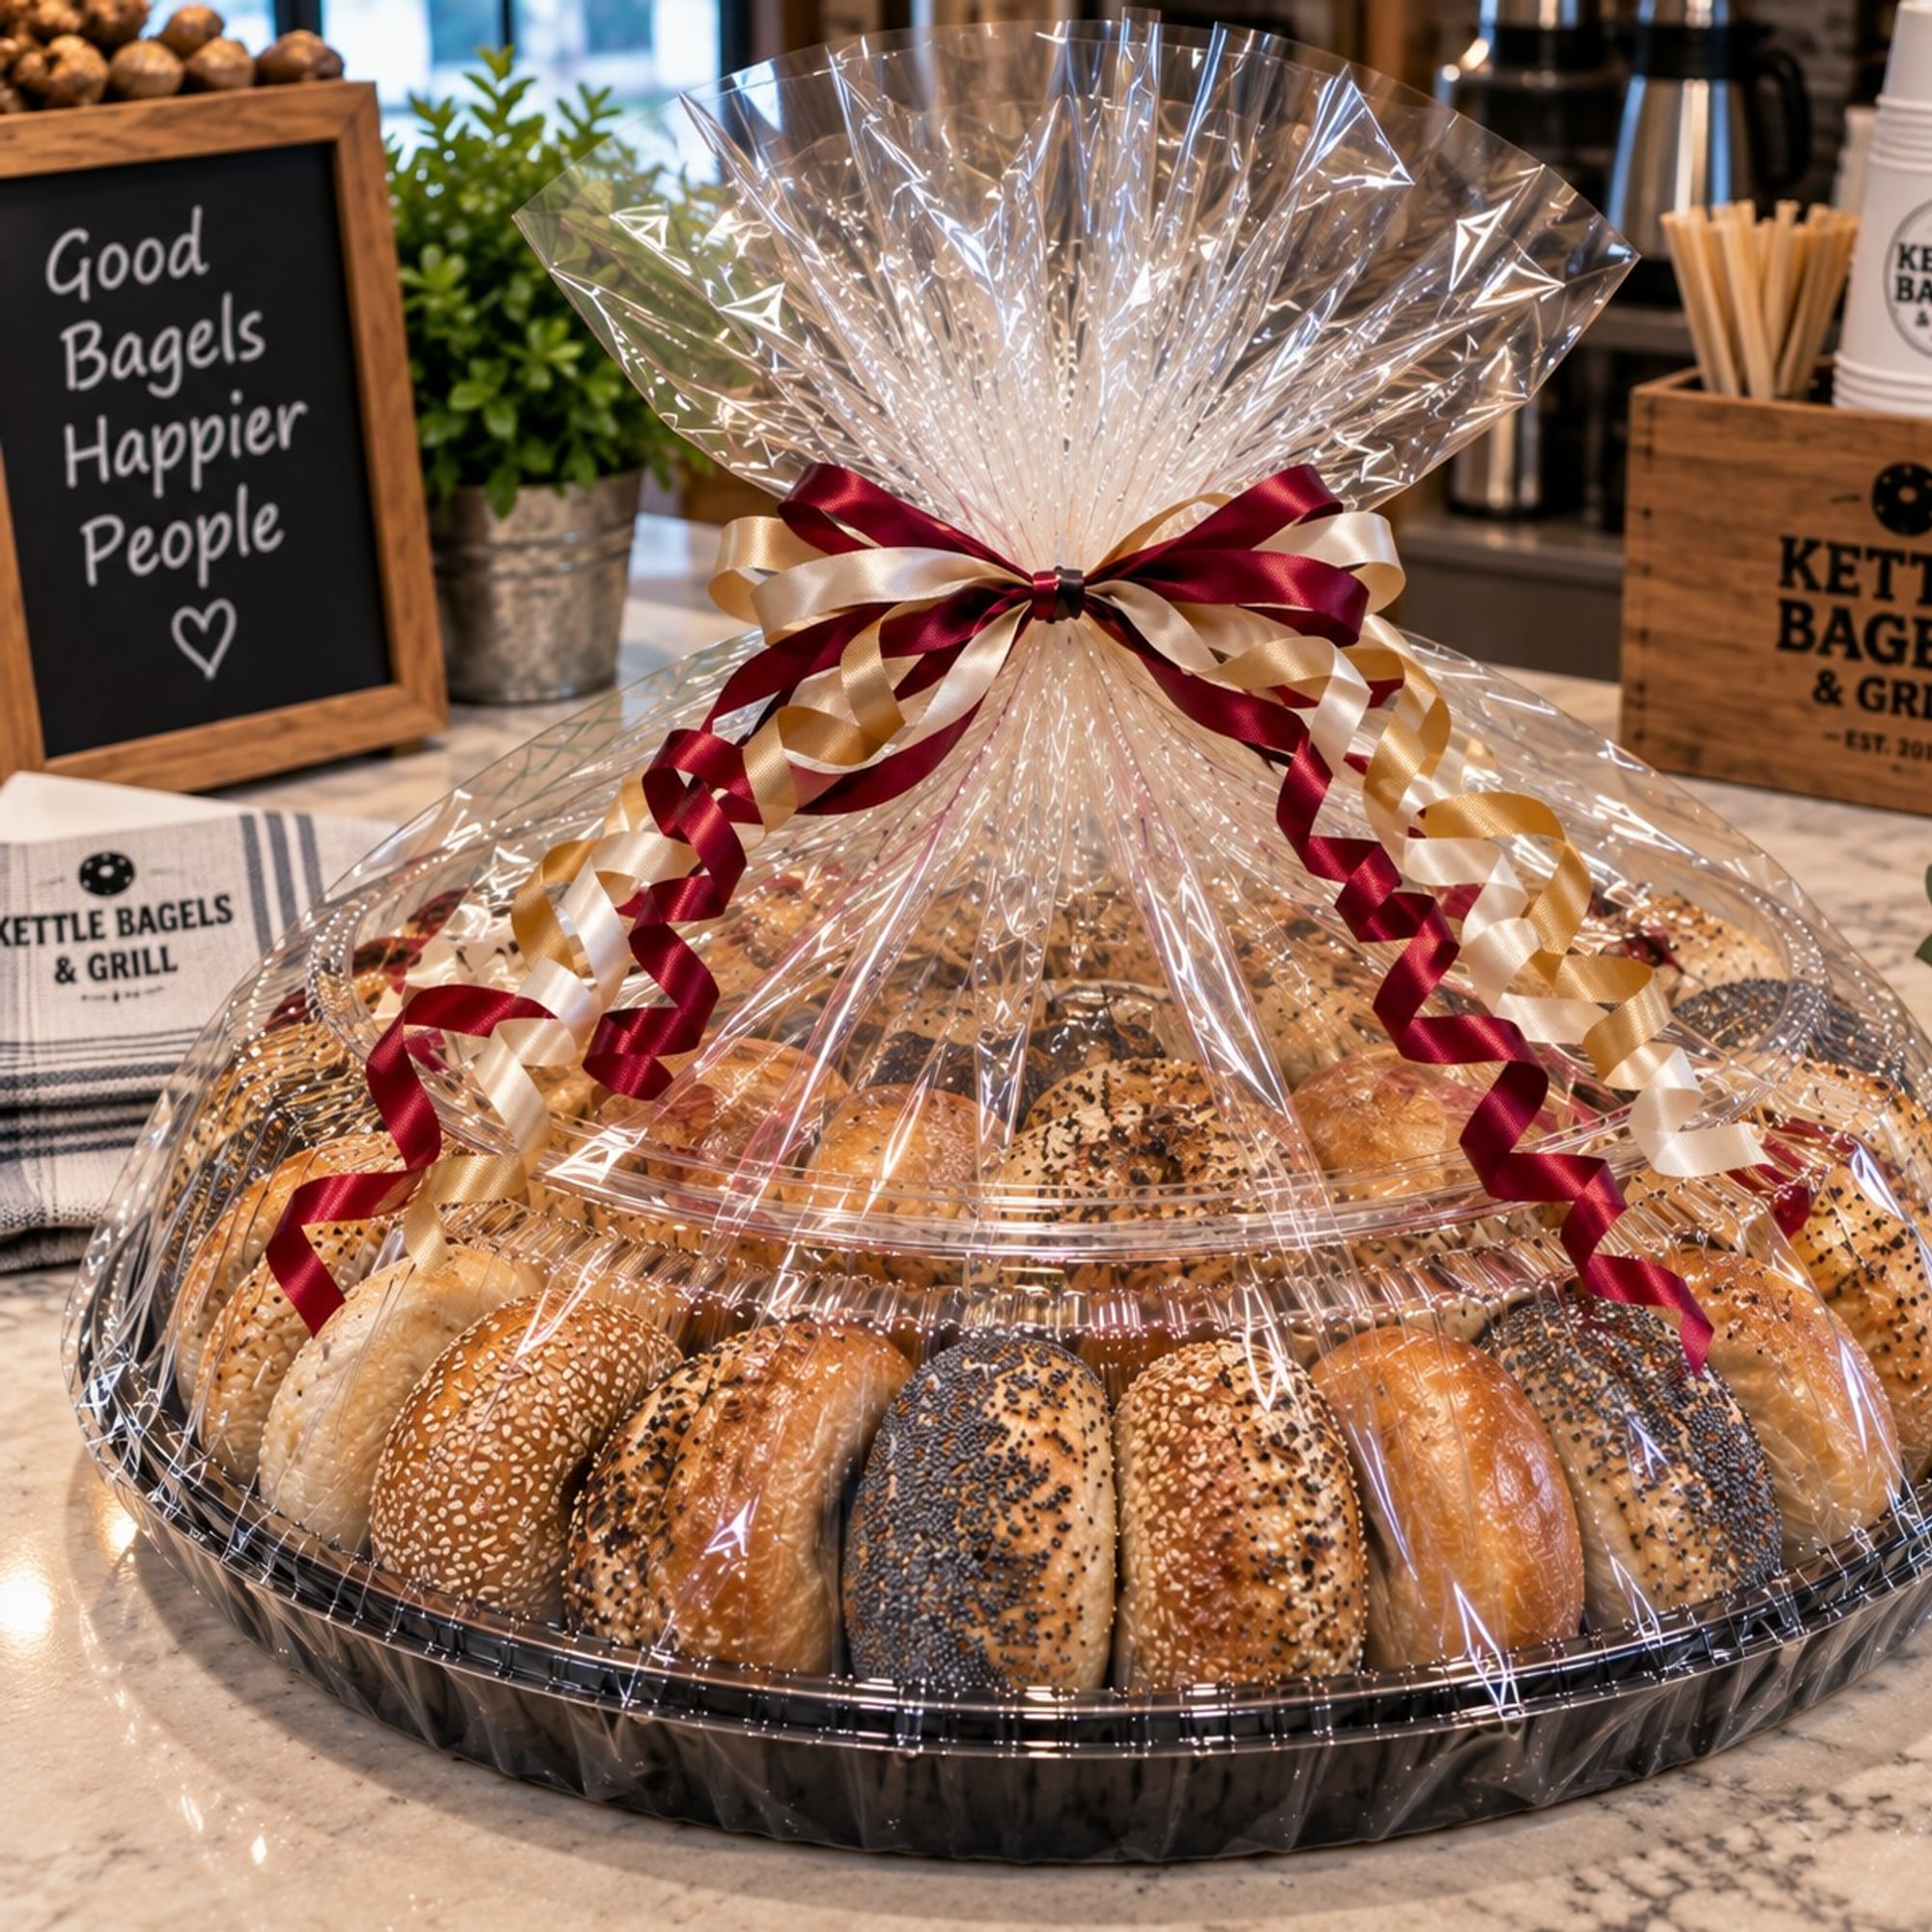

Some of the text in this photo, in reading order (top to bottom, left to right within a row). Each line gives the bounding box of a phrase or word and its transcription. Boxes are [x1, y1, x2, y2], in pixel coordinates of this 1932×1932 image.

[45, 205, 209, 302] Good
[60, 292, 267, 398] Bagels
[65, 389, 308, 498] Happier
[80, 483, 284, 588] People
[1813, 669, 1843, 708] &
[115, 895, 234, 938] BAGELS
[54, 946, 178, 985] & GRILL
